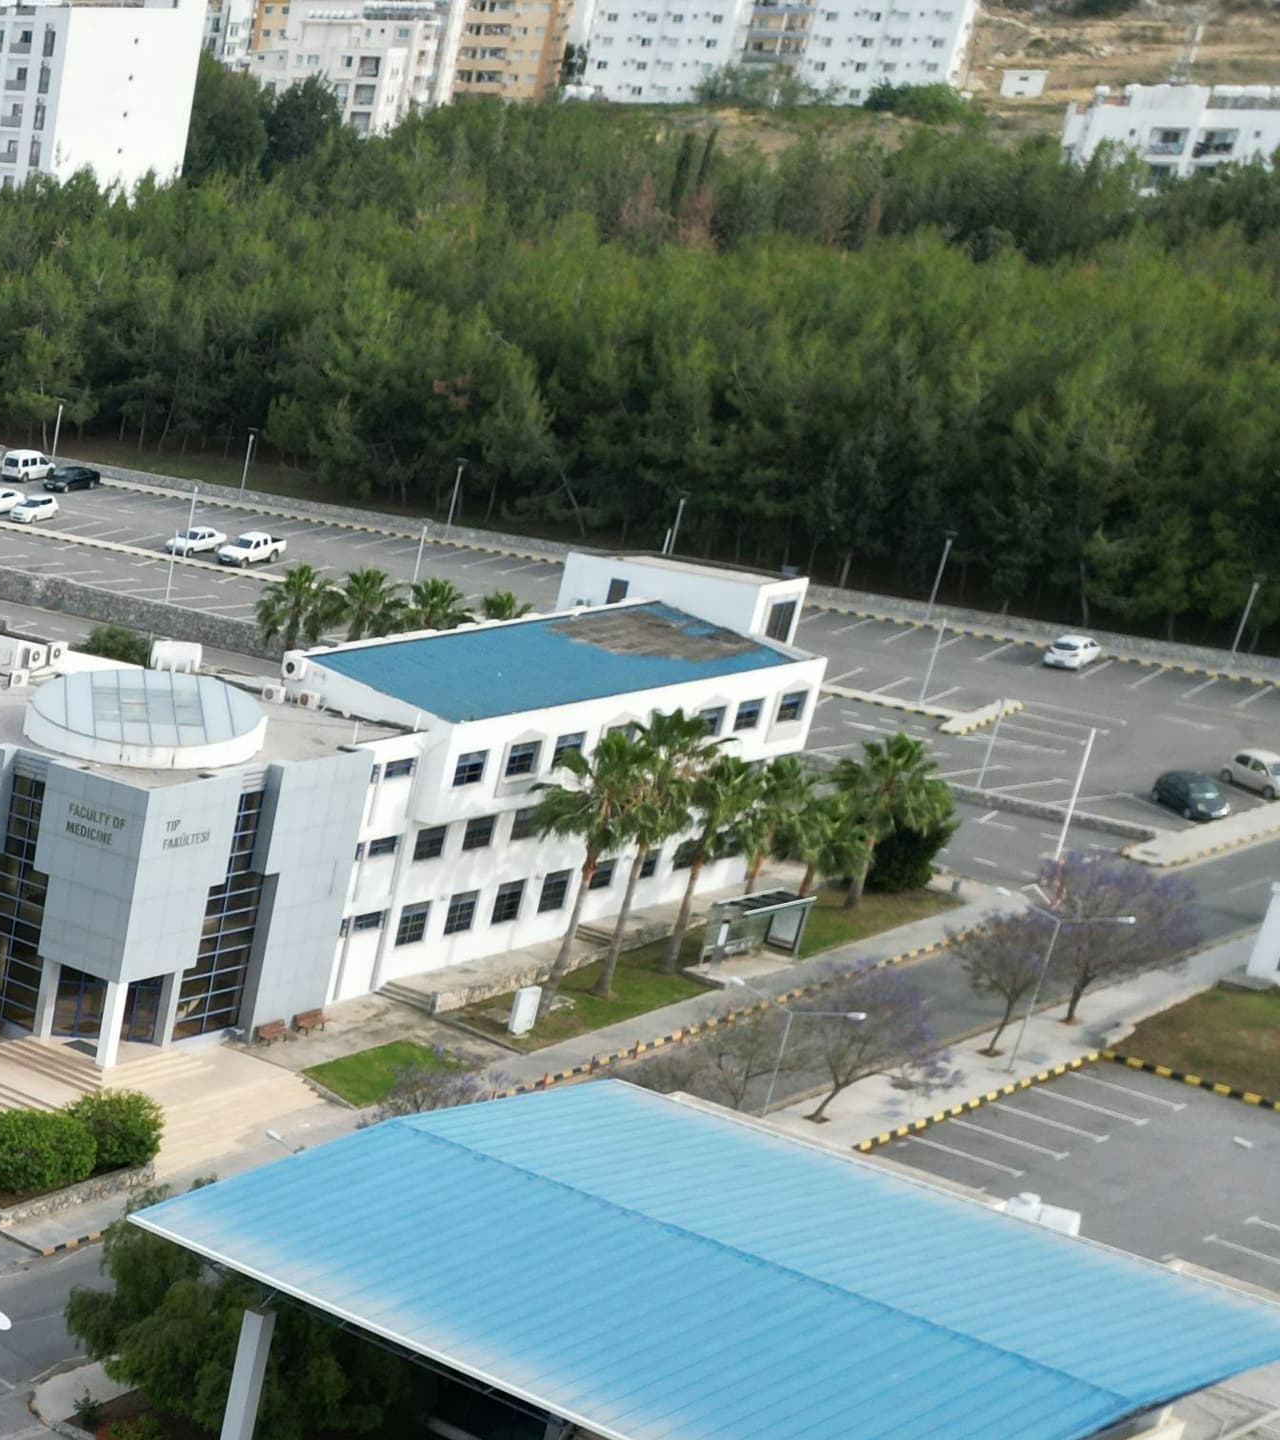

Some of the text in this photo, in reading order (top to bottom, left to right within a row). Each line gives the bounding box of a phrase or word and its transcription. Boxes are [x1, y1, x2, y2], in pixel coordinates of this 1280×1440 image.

[68, 802, 127, 831] FACULTY OF
[166, 819, 181, 833] TIP
[65, 821, 113, 846] MEDICINE
